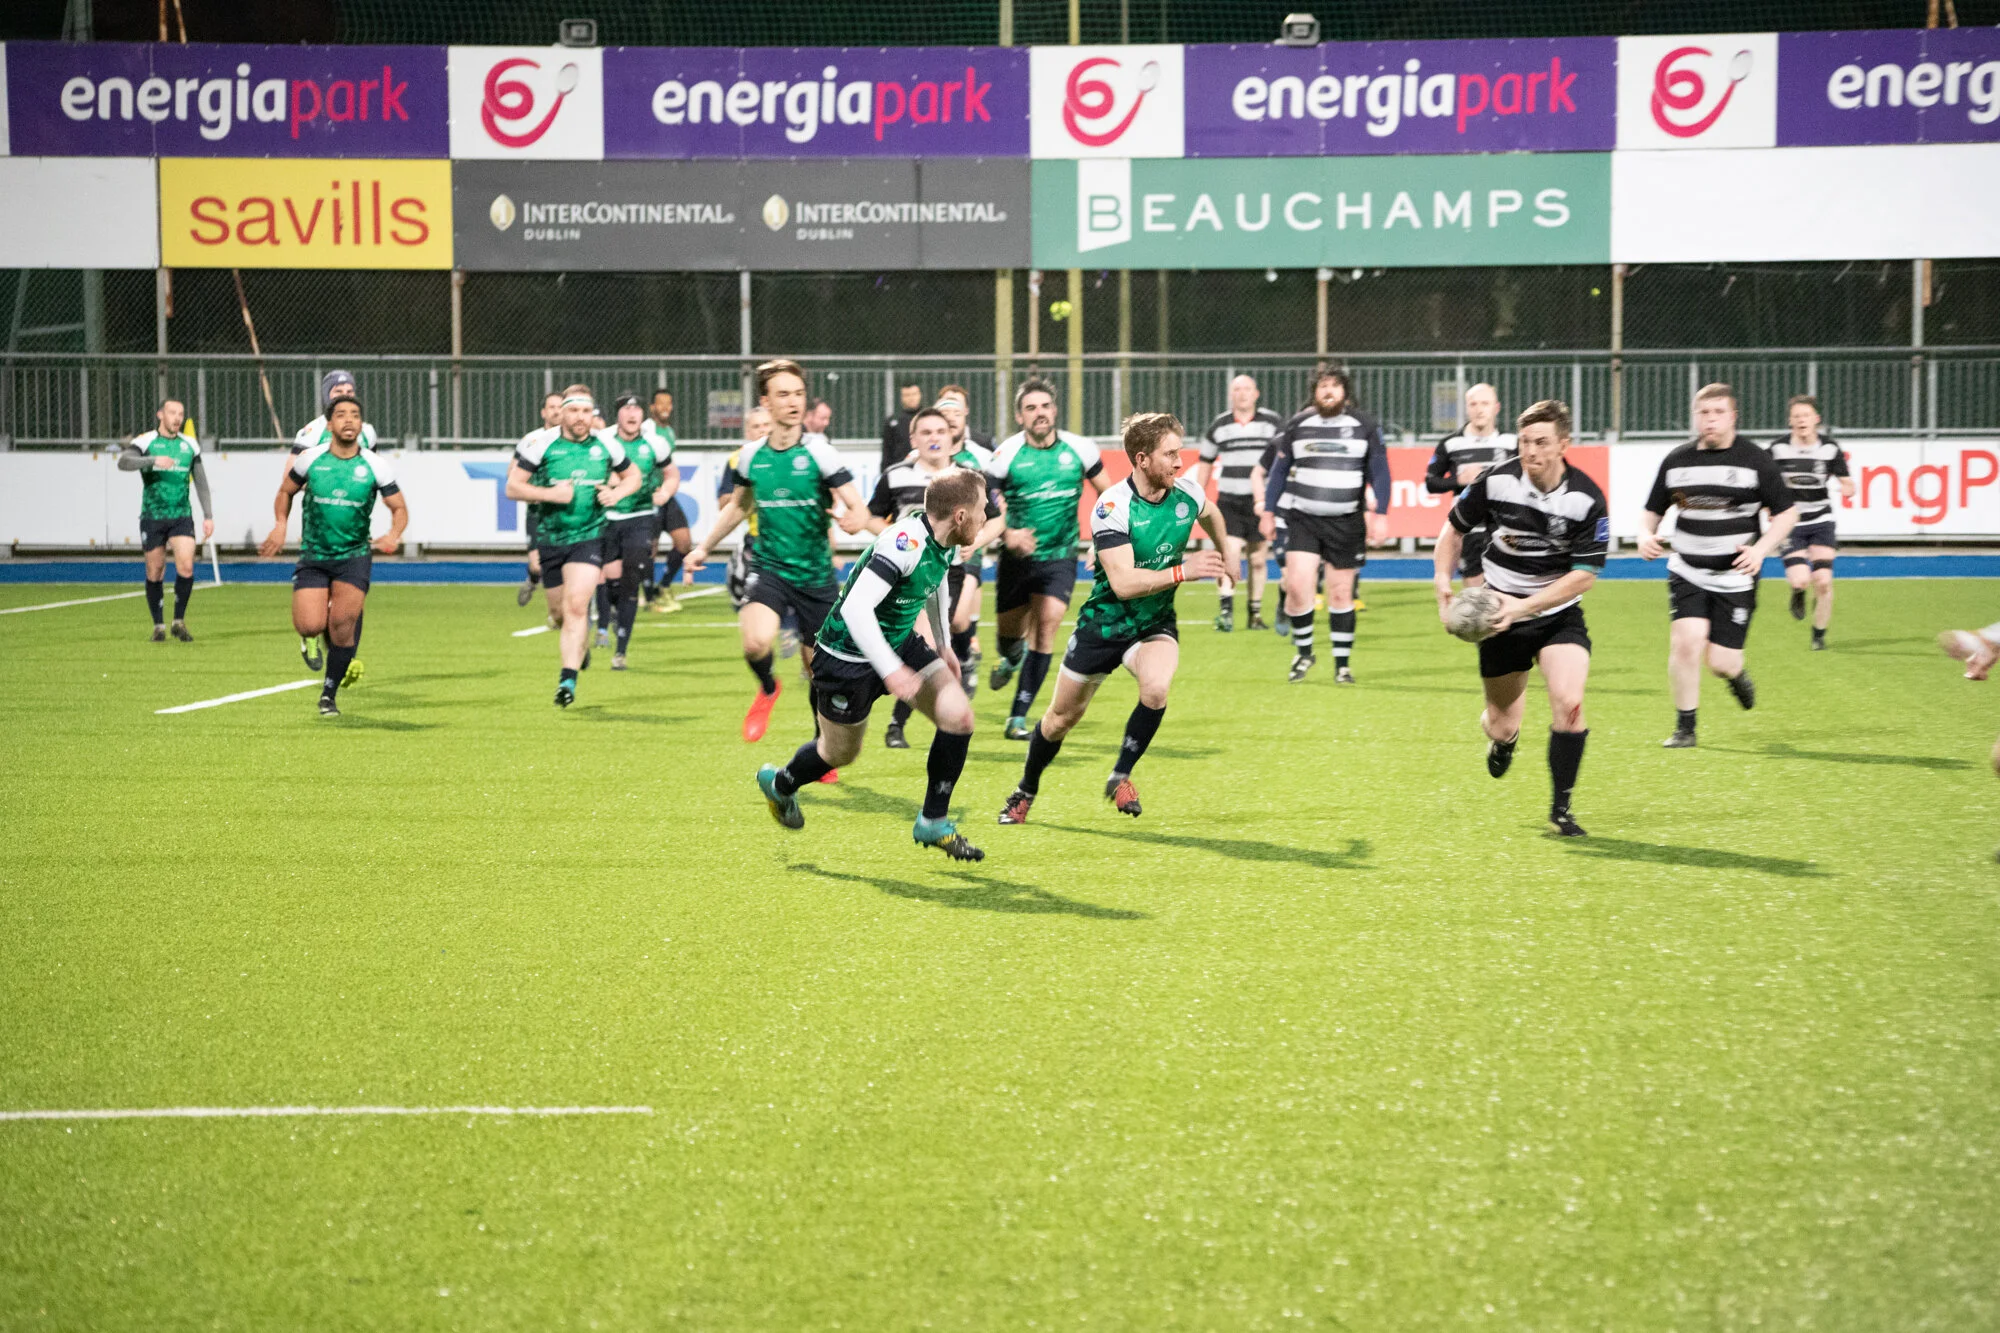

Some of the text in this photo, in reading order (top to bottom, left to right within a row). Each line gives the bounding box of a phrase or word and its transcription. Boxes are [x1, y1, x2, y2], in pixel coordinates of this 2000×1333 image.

[189, 180, 430, 247] savills
[1088, 188, 1571, 232] BEAUCHAMPS
[524, 228, 581, 241] DUBLIN
[796, 227, 854, 241] DUBLIN
